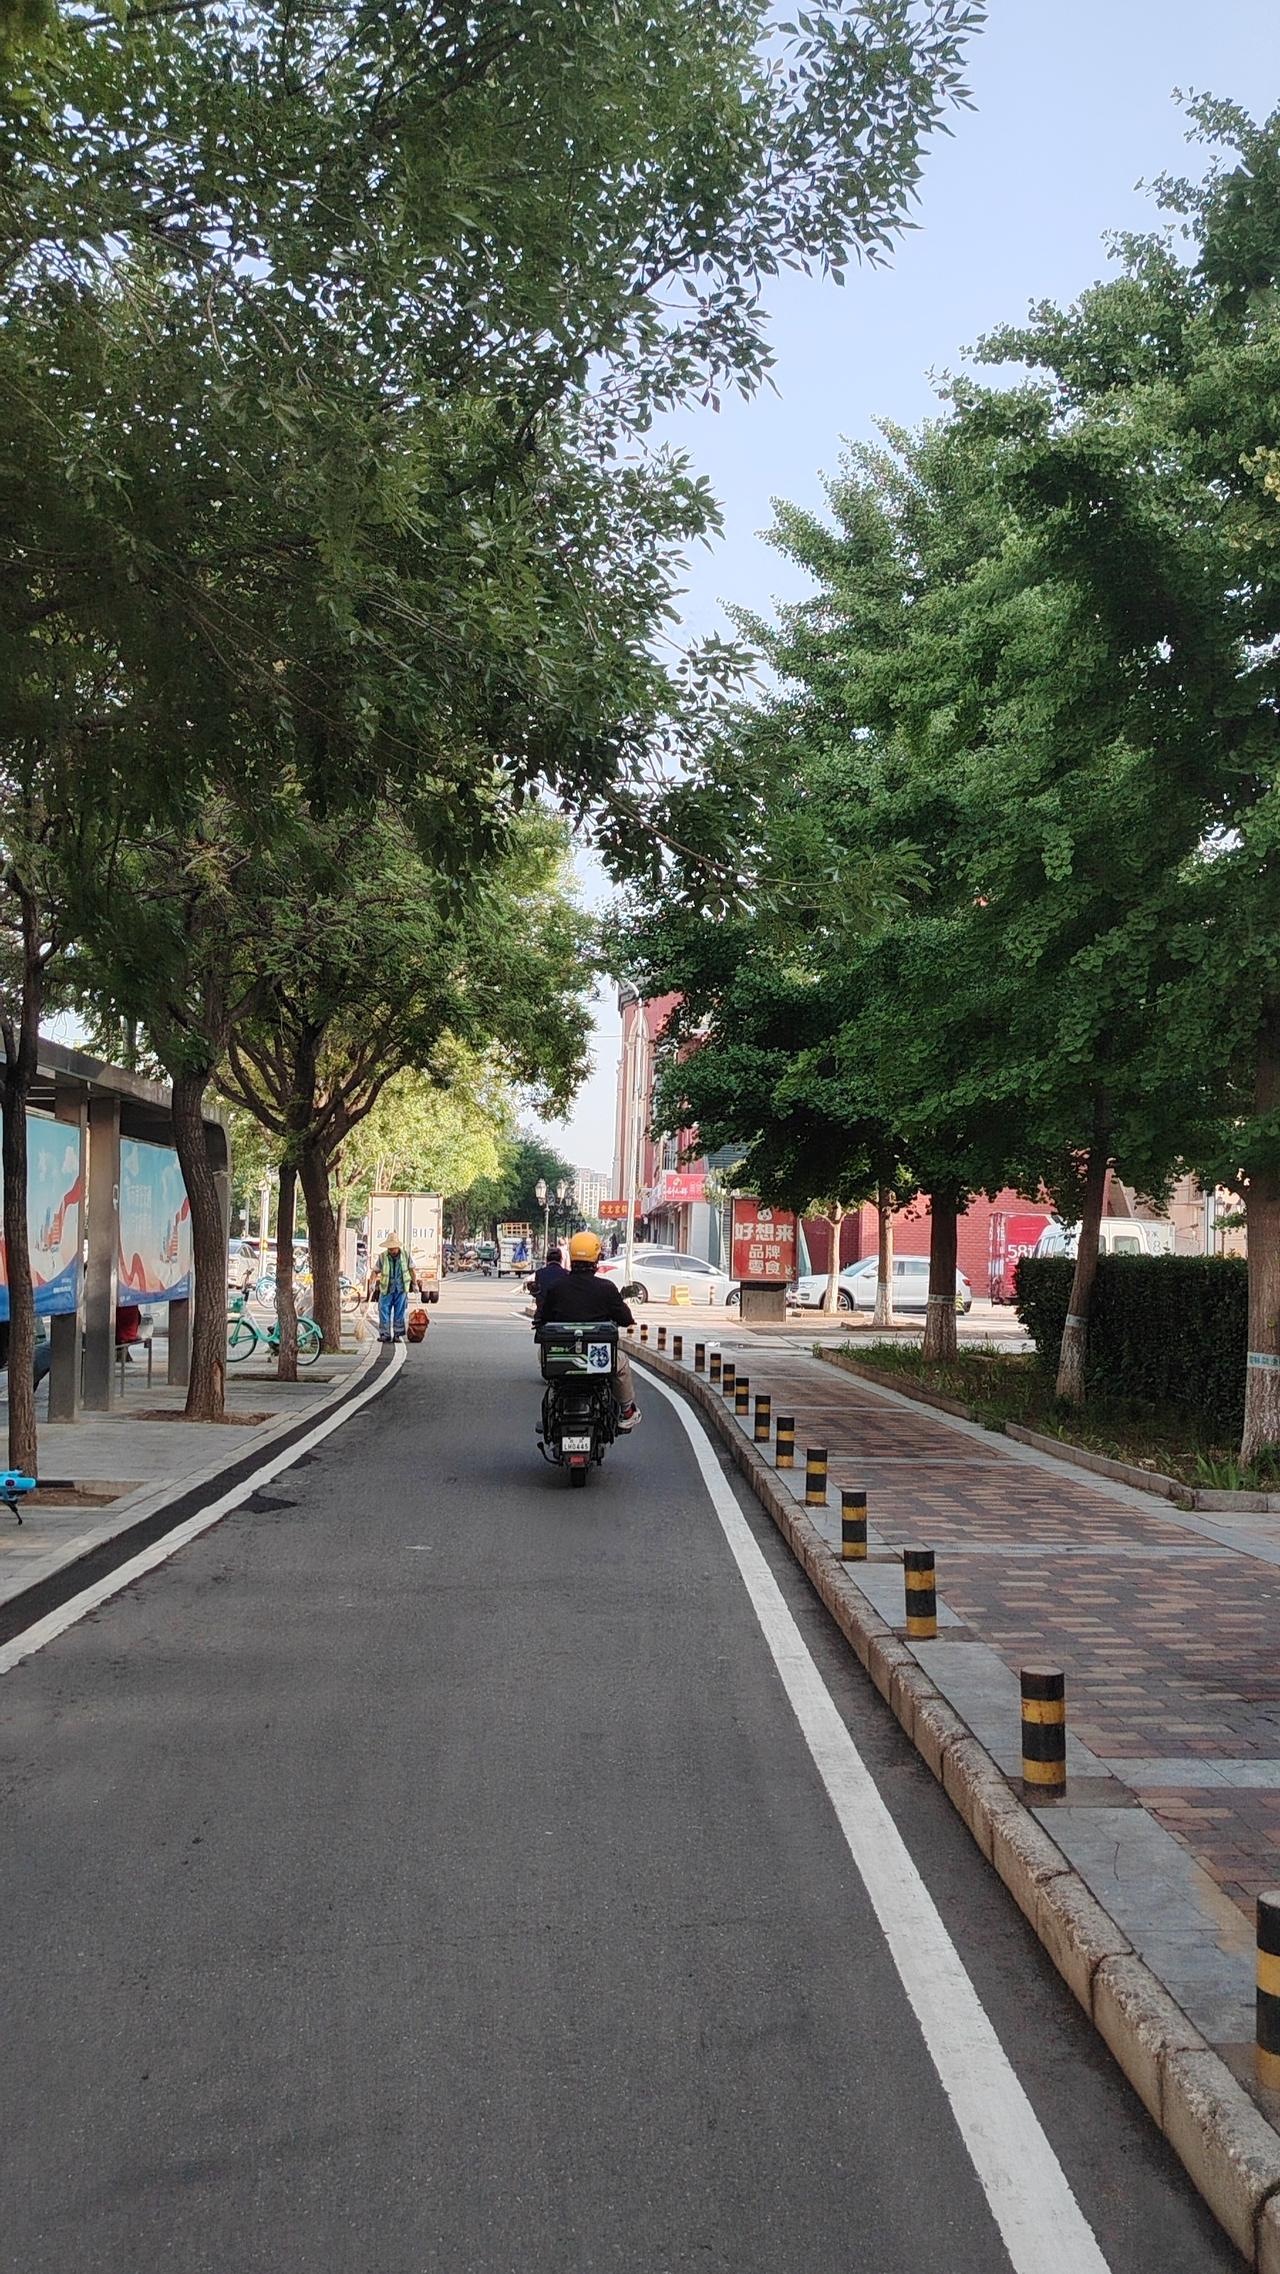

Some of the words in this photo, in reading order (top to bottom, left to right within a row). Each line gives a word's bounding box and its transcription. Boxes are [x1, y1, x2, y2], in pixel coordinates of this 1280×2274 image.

[735, 1222, 794, 1242] 好想来
[749, 1244, 780, 1260] 品牌
[749, 1259, 780, 1275] 零食
